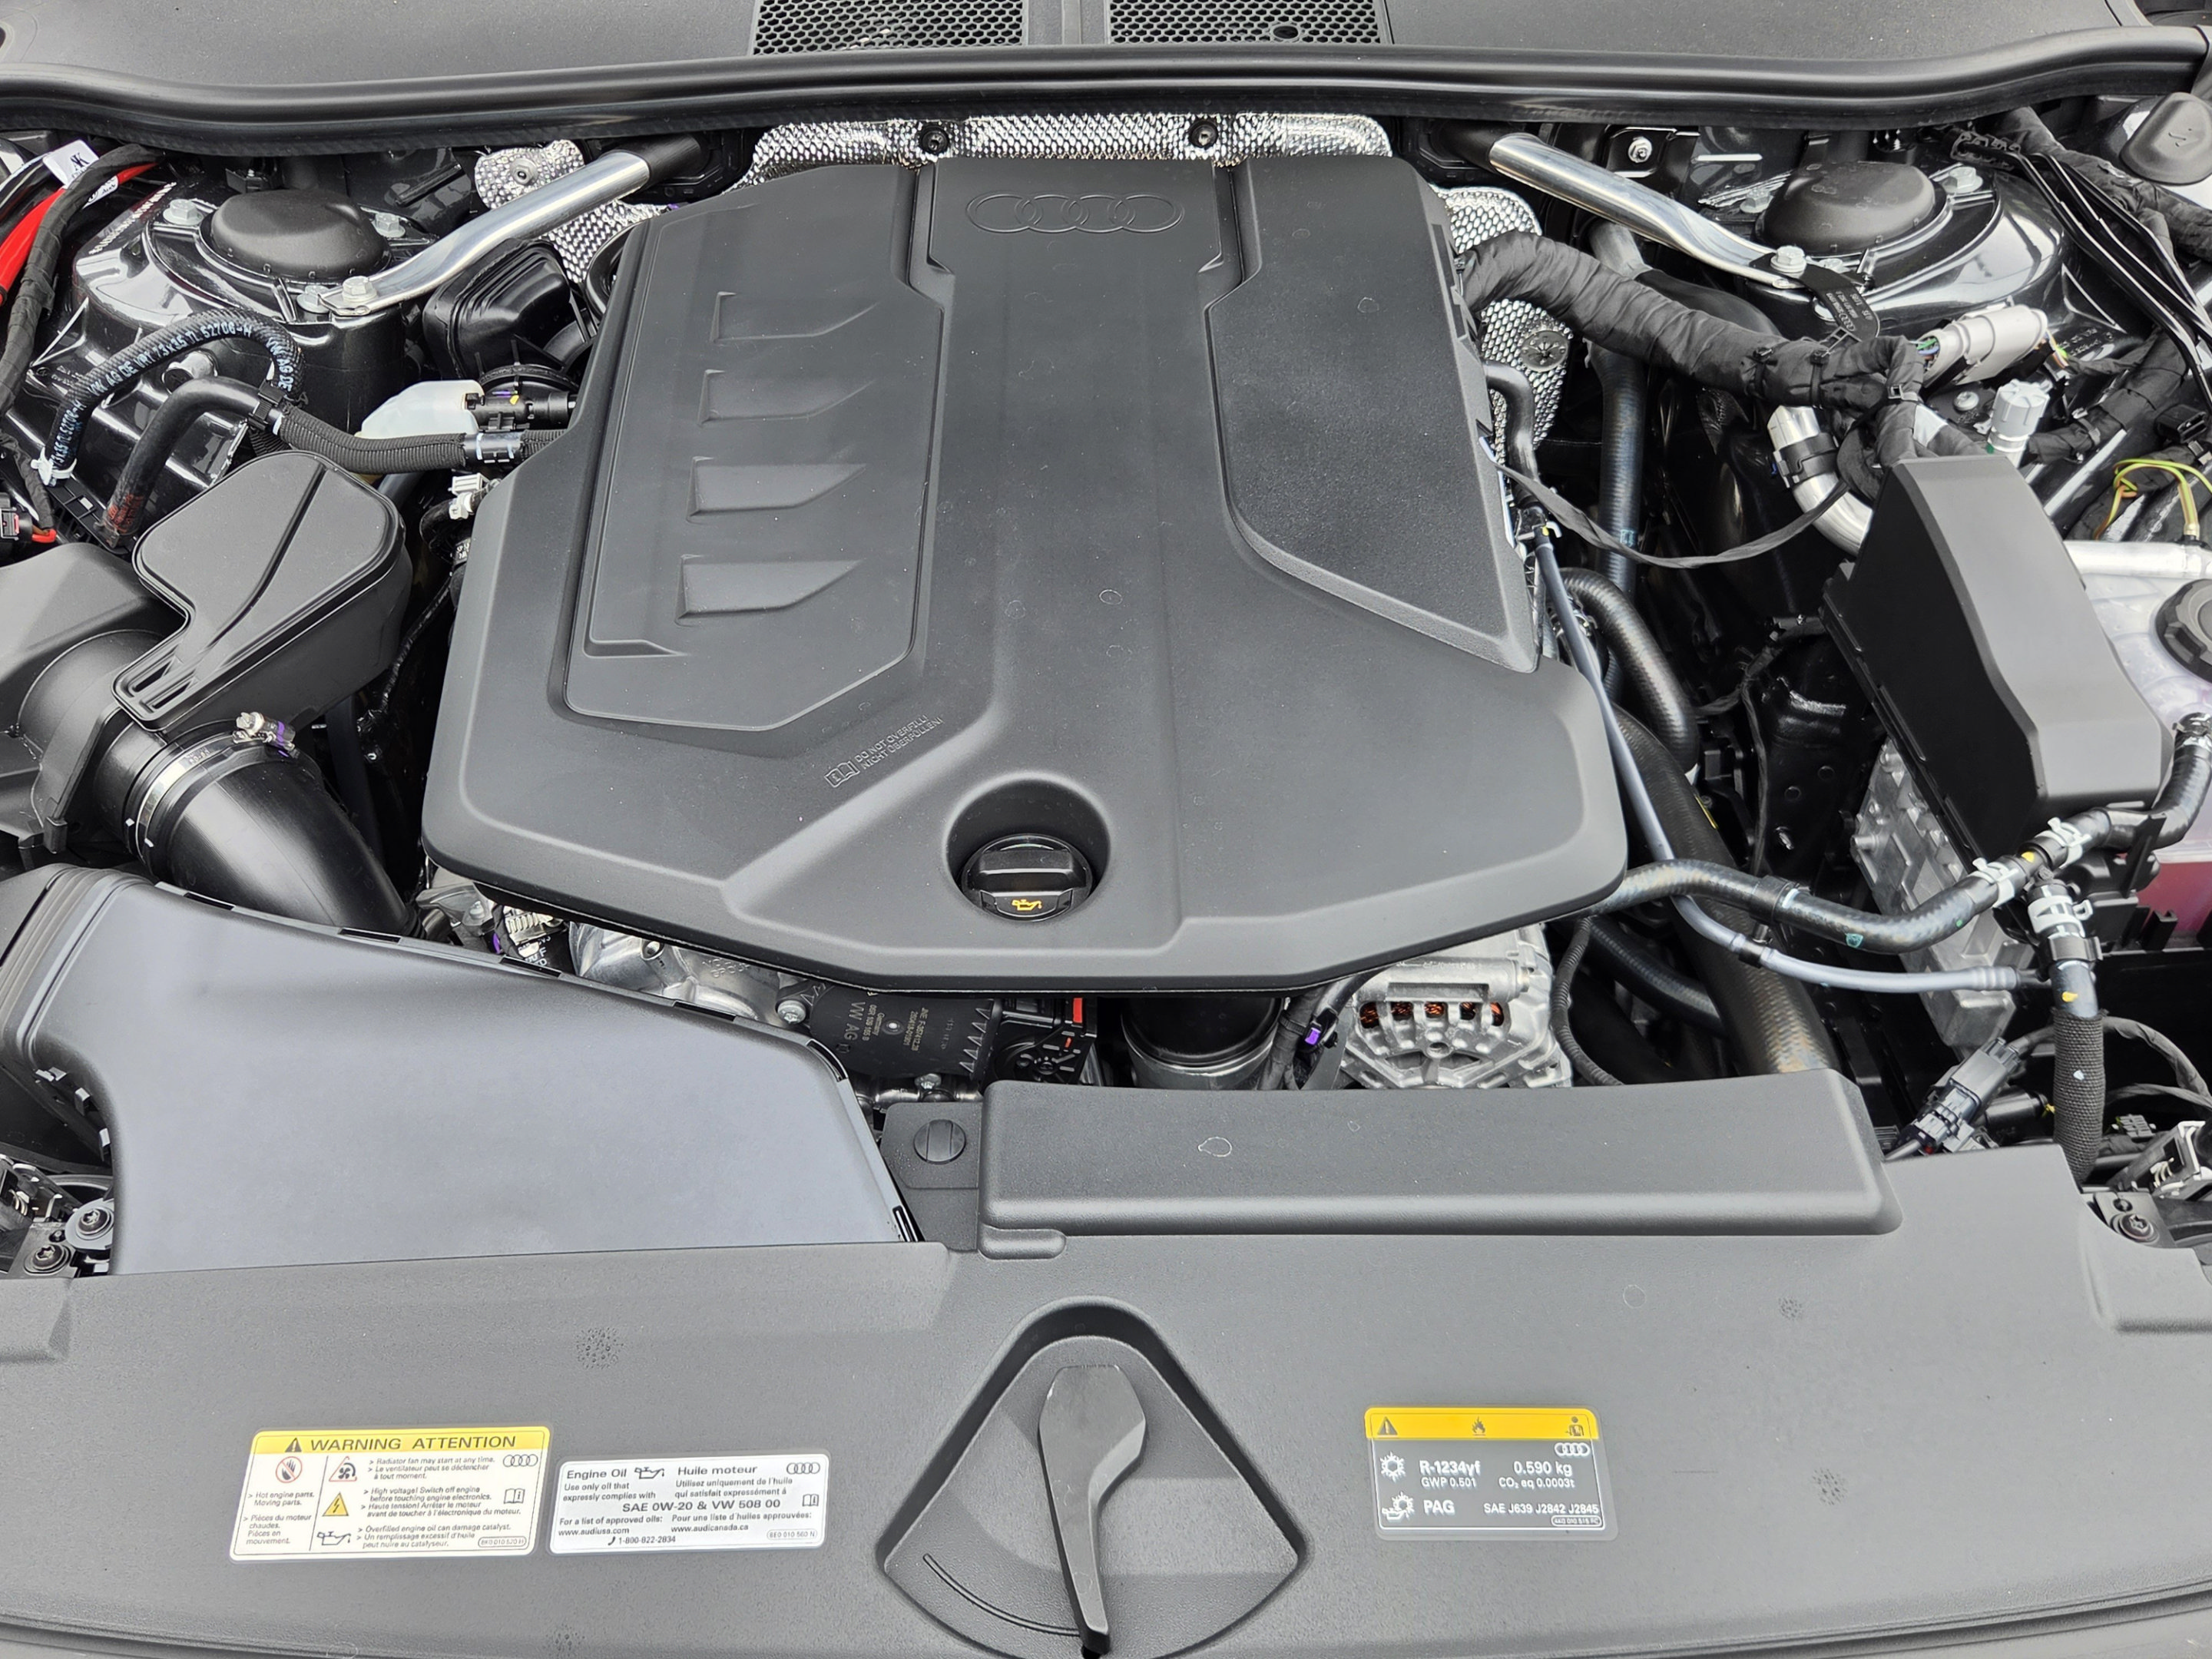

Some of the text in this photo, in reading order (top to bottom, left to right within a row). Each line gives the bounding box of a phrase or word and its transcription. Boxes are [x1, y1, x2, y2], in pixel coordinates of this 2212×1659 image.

[266, 336, 289, 359] VW
[118, 361, 138, 377] DE
[276, 356, 294, 376] AG
[106, 371, 121, 386] AG
[277, 373, 295, 393] DE
[88, 381, 108, 396] VW
[854, 714, 930, 763] DO NOT OVERFILL!
[860, 749, 889, 770] NICHT
[843, 1001, 866, 1041] VW AG
[311, 1435, 516, 1451] WARNING ATTENTION
[424, 1465, 440, 1473] peut
[677, 1465, 757, 1475] Huile moteur
[1419, 1459, 1573, 1475] R-1234yf 0.590 kg
[567, 1468, 627, 1480] Engine Oil
[676, 1479, 705, 1488] Utilisez
[707, 1479, 754, 1488] uniquement
[1421, 1477, 1477, 1488] GWP 0.501
[1521, 1479, 1534, 1489] eq
[1535, 1477, 1575, 1488] 0.0003t
[371, 1487, 388, 1495] High
[389, 1487, 419, 1495] voltage!
[601, 1492, 637, 1501] complies
[674, 1490, 688, 1499] qui
[394, 1495, 423, 1503] touching
[622, 1498, 781, 1512] SAE 0W-20 & VW 508 00
[1423, 1499, 1455, 1514] PAG
[1483, 1503, 1599, 1514] SAE J639 J2842 J2845
[606, 1515, 644, 1525] approved
[401, 1525, 426, 1534] engine
[558, 1528, 630, 1536] www.audiusa.com
[671, 1524, 749, 1533] www.audicanada.ca
[376, 1533, 419, 1542] remplissage
[618, 1536, 676, 1545] 1-800-822-2834
[363, 1541, 379, 1549] peut
[411, 1540, 449, 1548] catalyseur.
